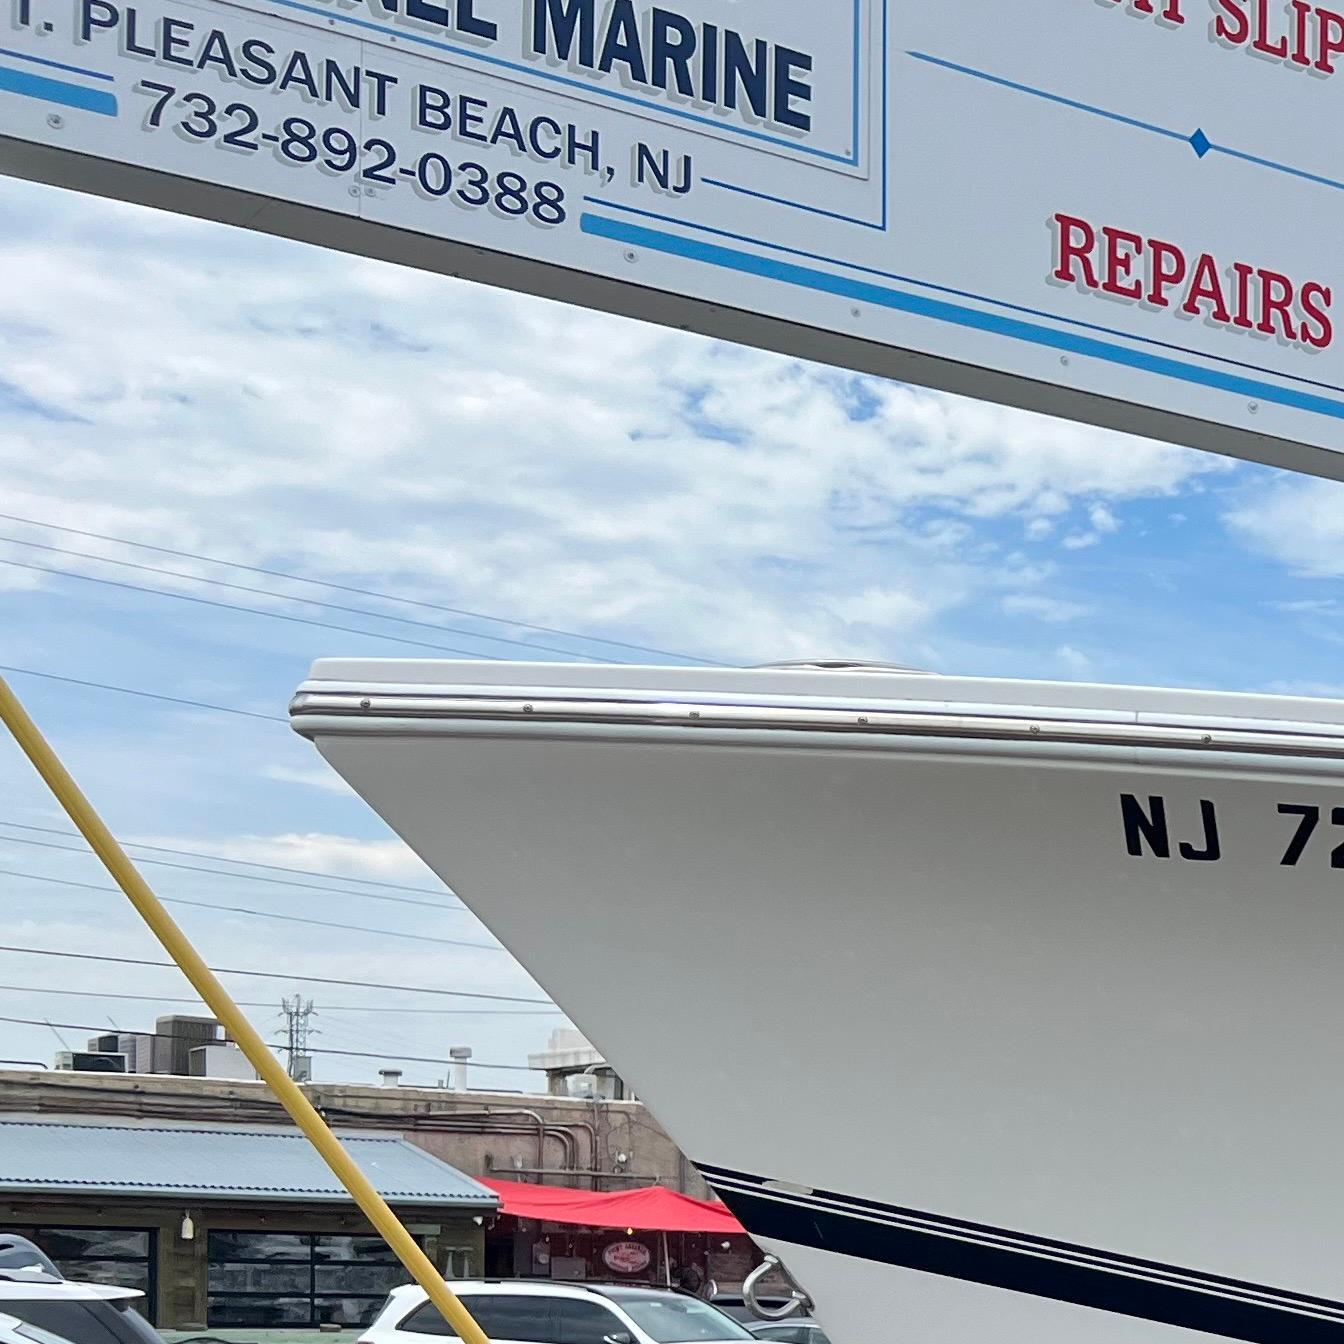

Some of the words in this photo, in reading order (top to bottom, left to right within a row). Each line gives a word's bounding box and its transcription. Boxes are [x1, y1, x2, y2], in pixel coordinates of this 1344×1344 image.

[80, 0, 398, 117] PLEASANT
[418, 84, 616, 183] BEACH,
[637, 142, 692, 195] NJ
[533, 0, 813, 132] MARINE
[140, 80, 566, 226] 732-892-0388
[1054, 212, 1333, 349] REPAIRS
[1119, 793, 1221, 861] NJ
